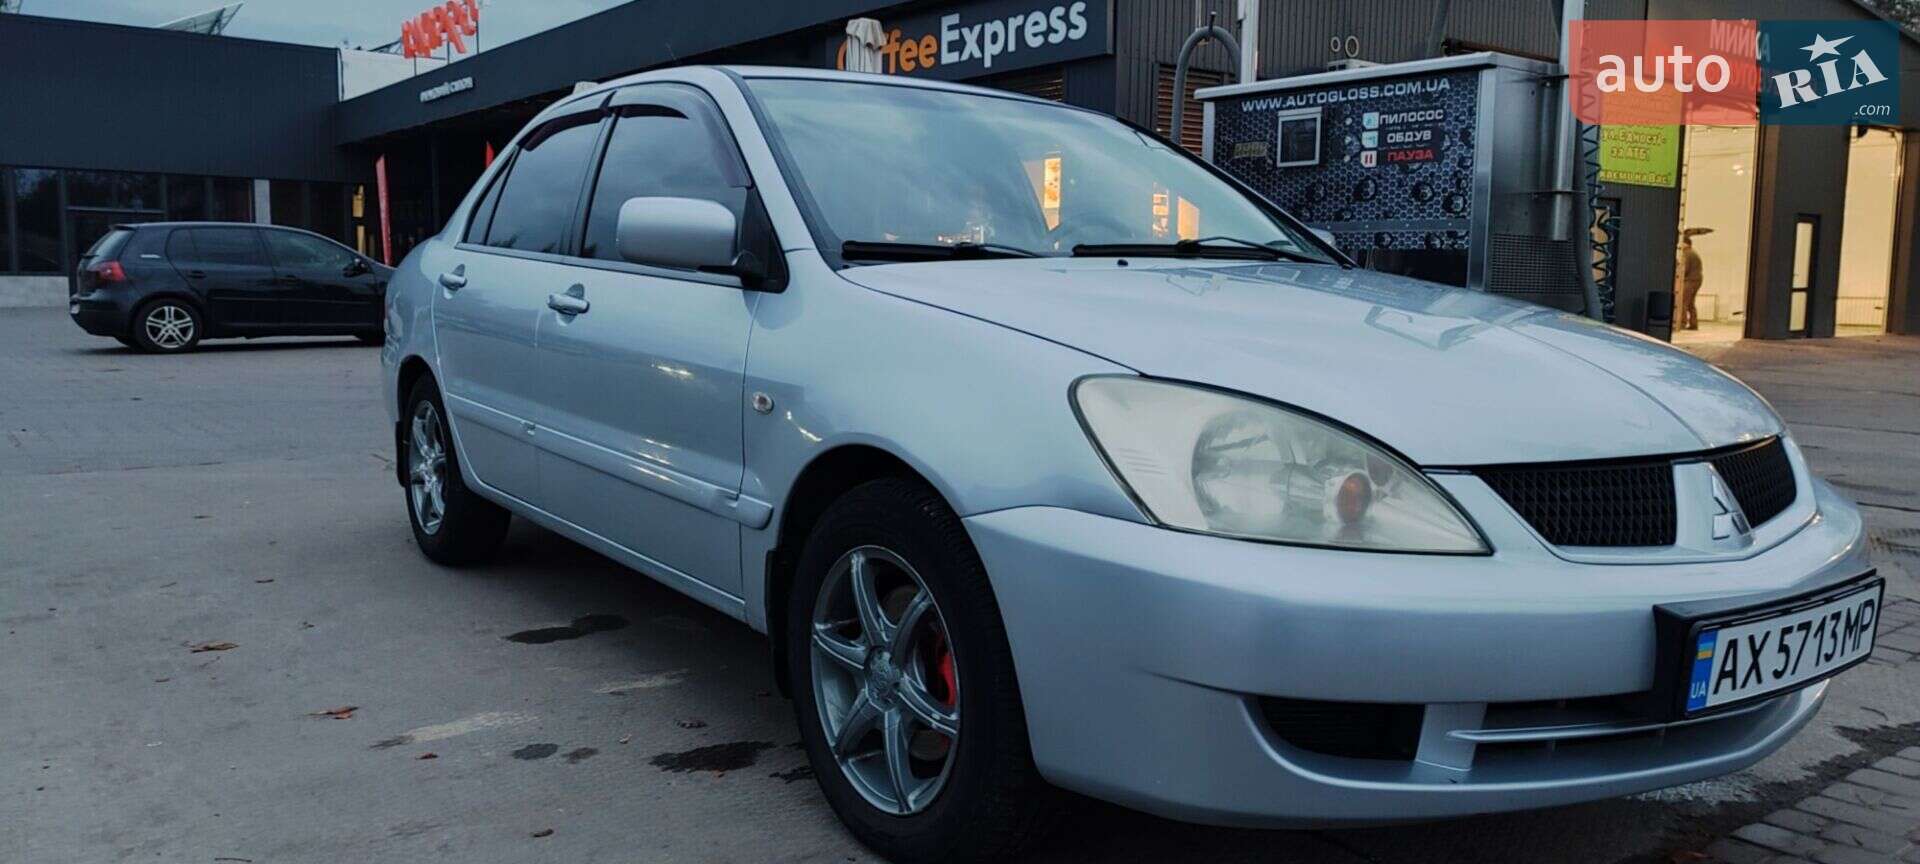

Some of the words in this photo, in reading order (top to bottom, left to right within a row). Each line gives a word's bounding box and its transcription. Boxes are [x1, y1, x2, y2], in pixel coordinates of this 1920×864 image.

[940, 1, 1087, 68] Express
[1241, 78, 1450, 113] WWW.AUTOGLOSS.COM.UA
[1379, 109, 1444, 125] ПИЛОСОС
[1387, 130, 1432, 143] ОБДУВ
[1387, 150, 1434, 162] ПАУЗА
[1713, 631, 1771, 695] AX
[1773, 609, 1842, 680] 5713
[1839, 598, 1876, 658] MP
[1690, 681, 1706, 699] UA
